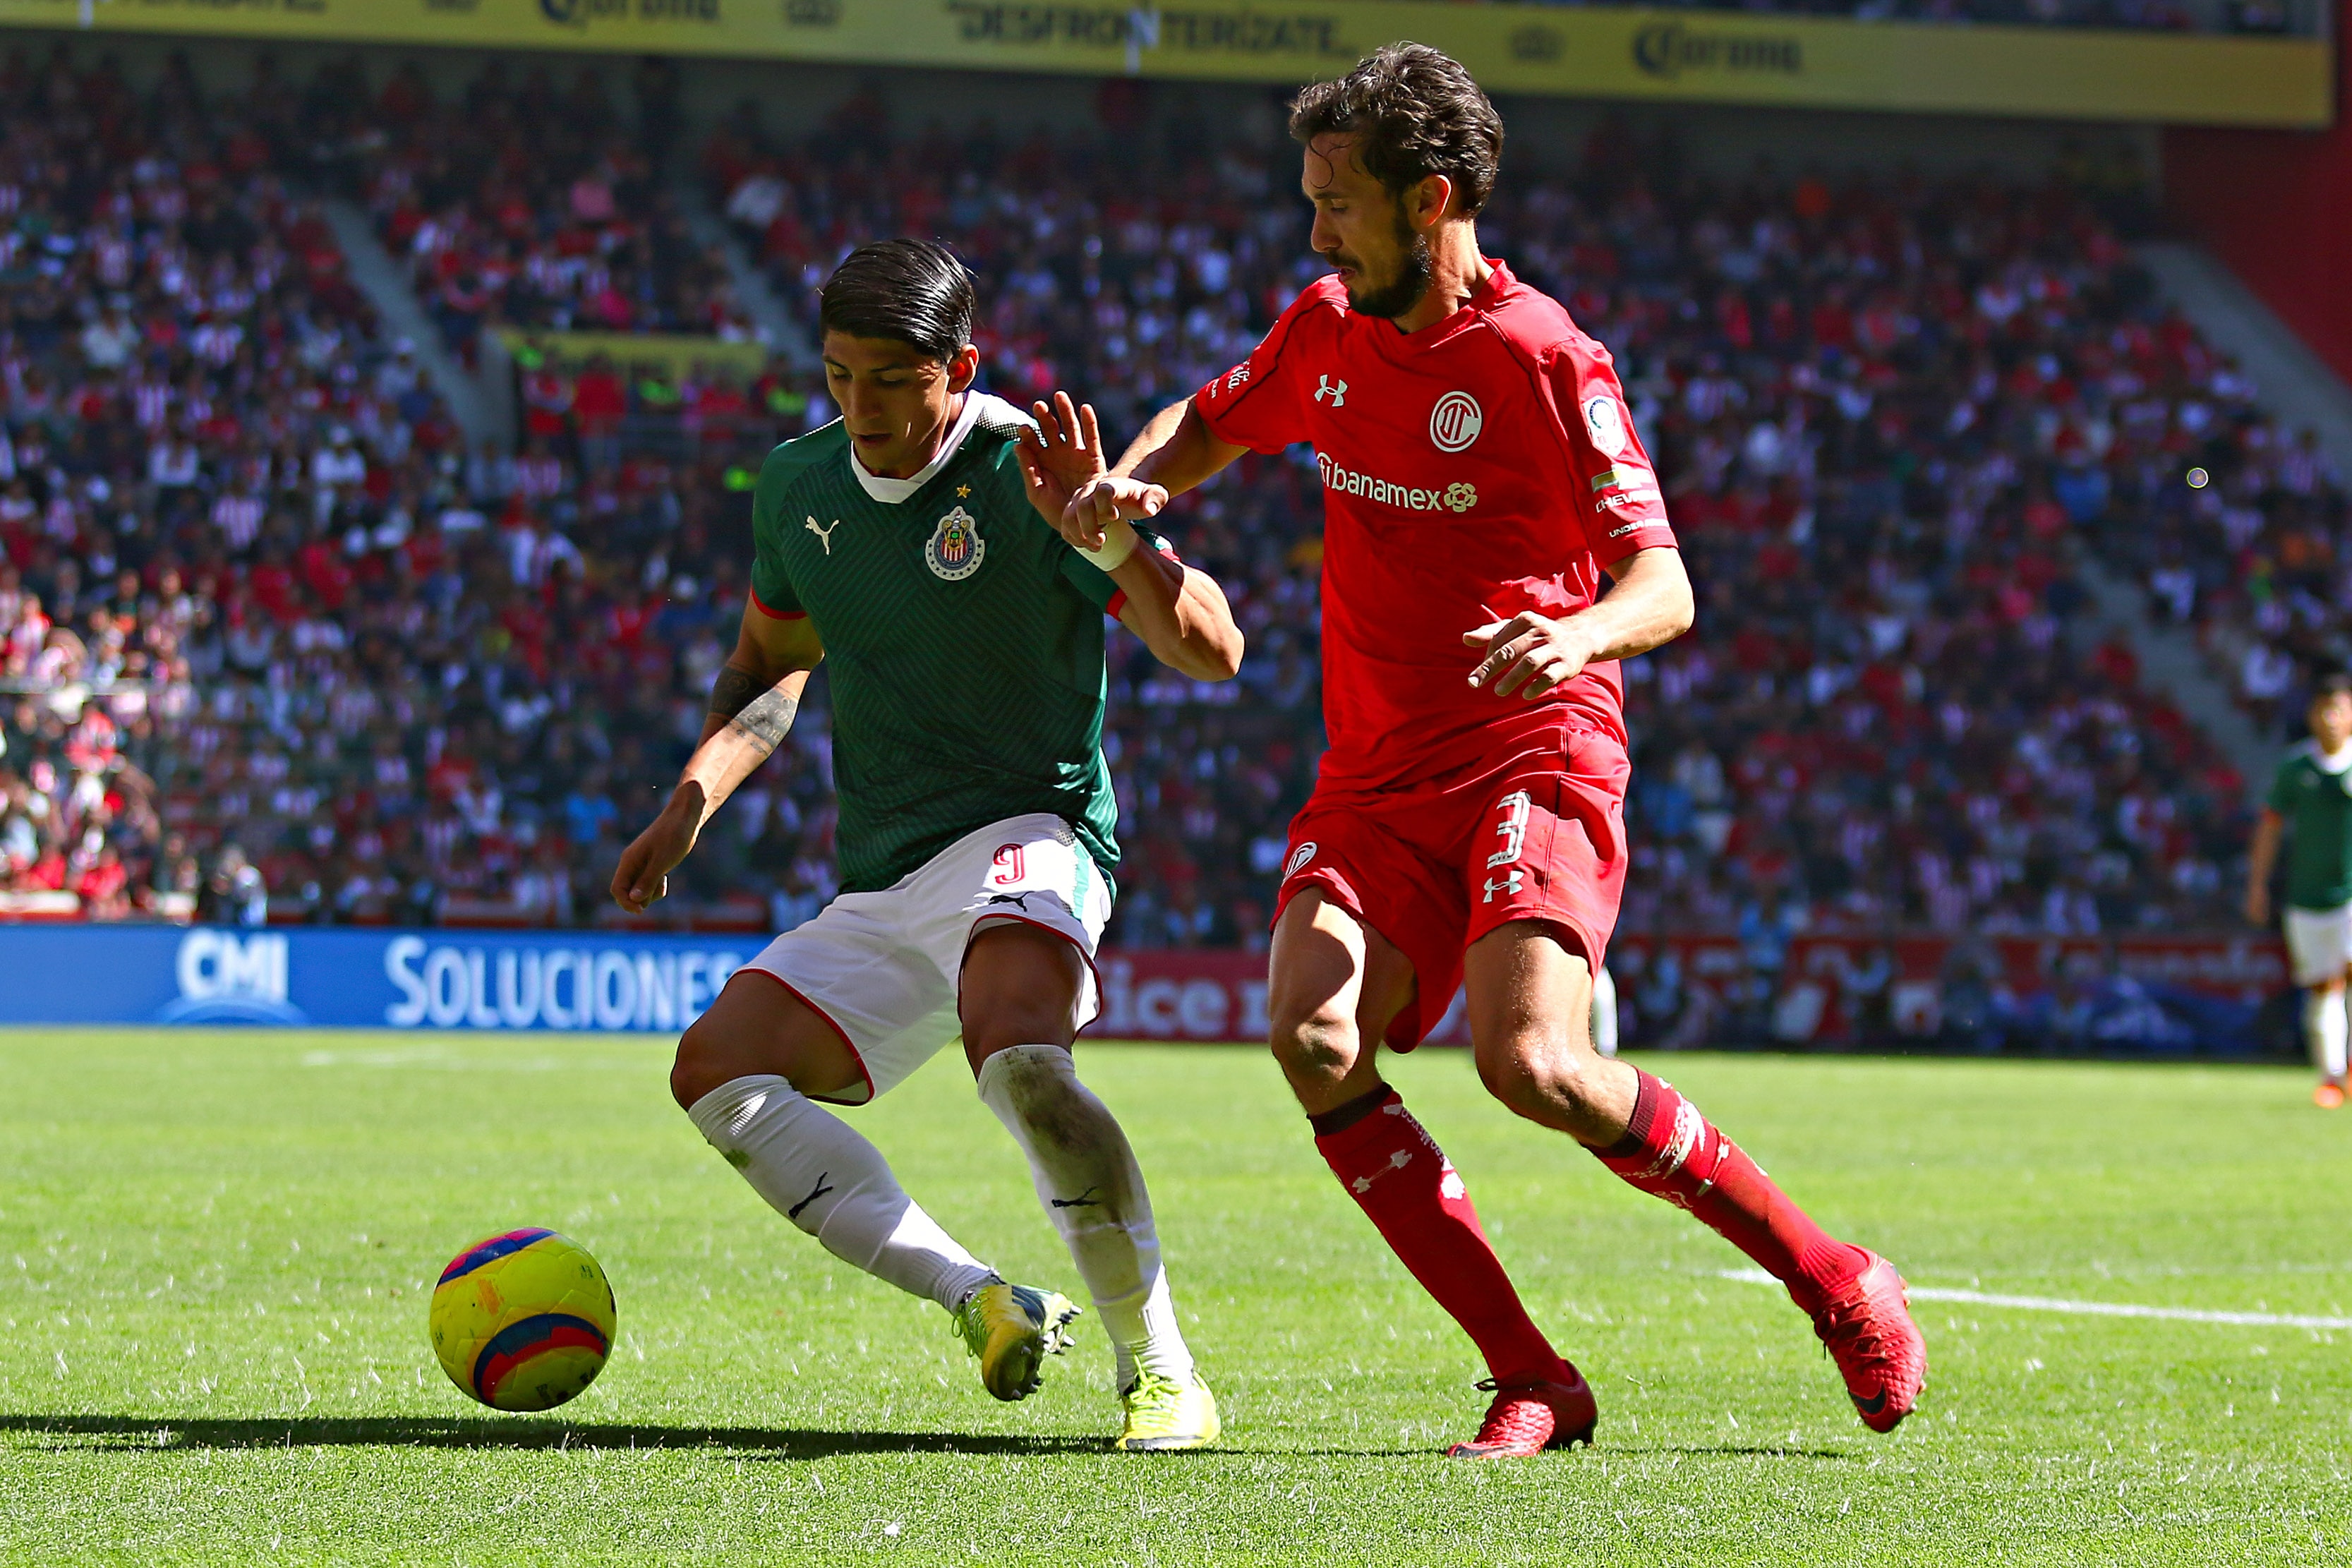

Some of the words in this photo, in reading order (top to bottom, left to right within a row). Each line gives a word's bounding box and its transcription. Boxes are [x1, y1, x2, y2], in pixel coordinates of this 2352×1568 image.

[993, 843, 1025, 885] 9
[1487, 790, 1531, 869] 3
[178, 927, 289, 1003] CMI
